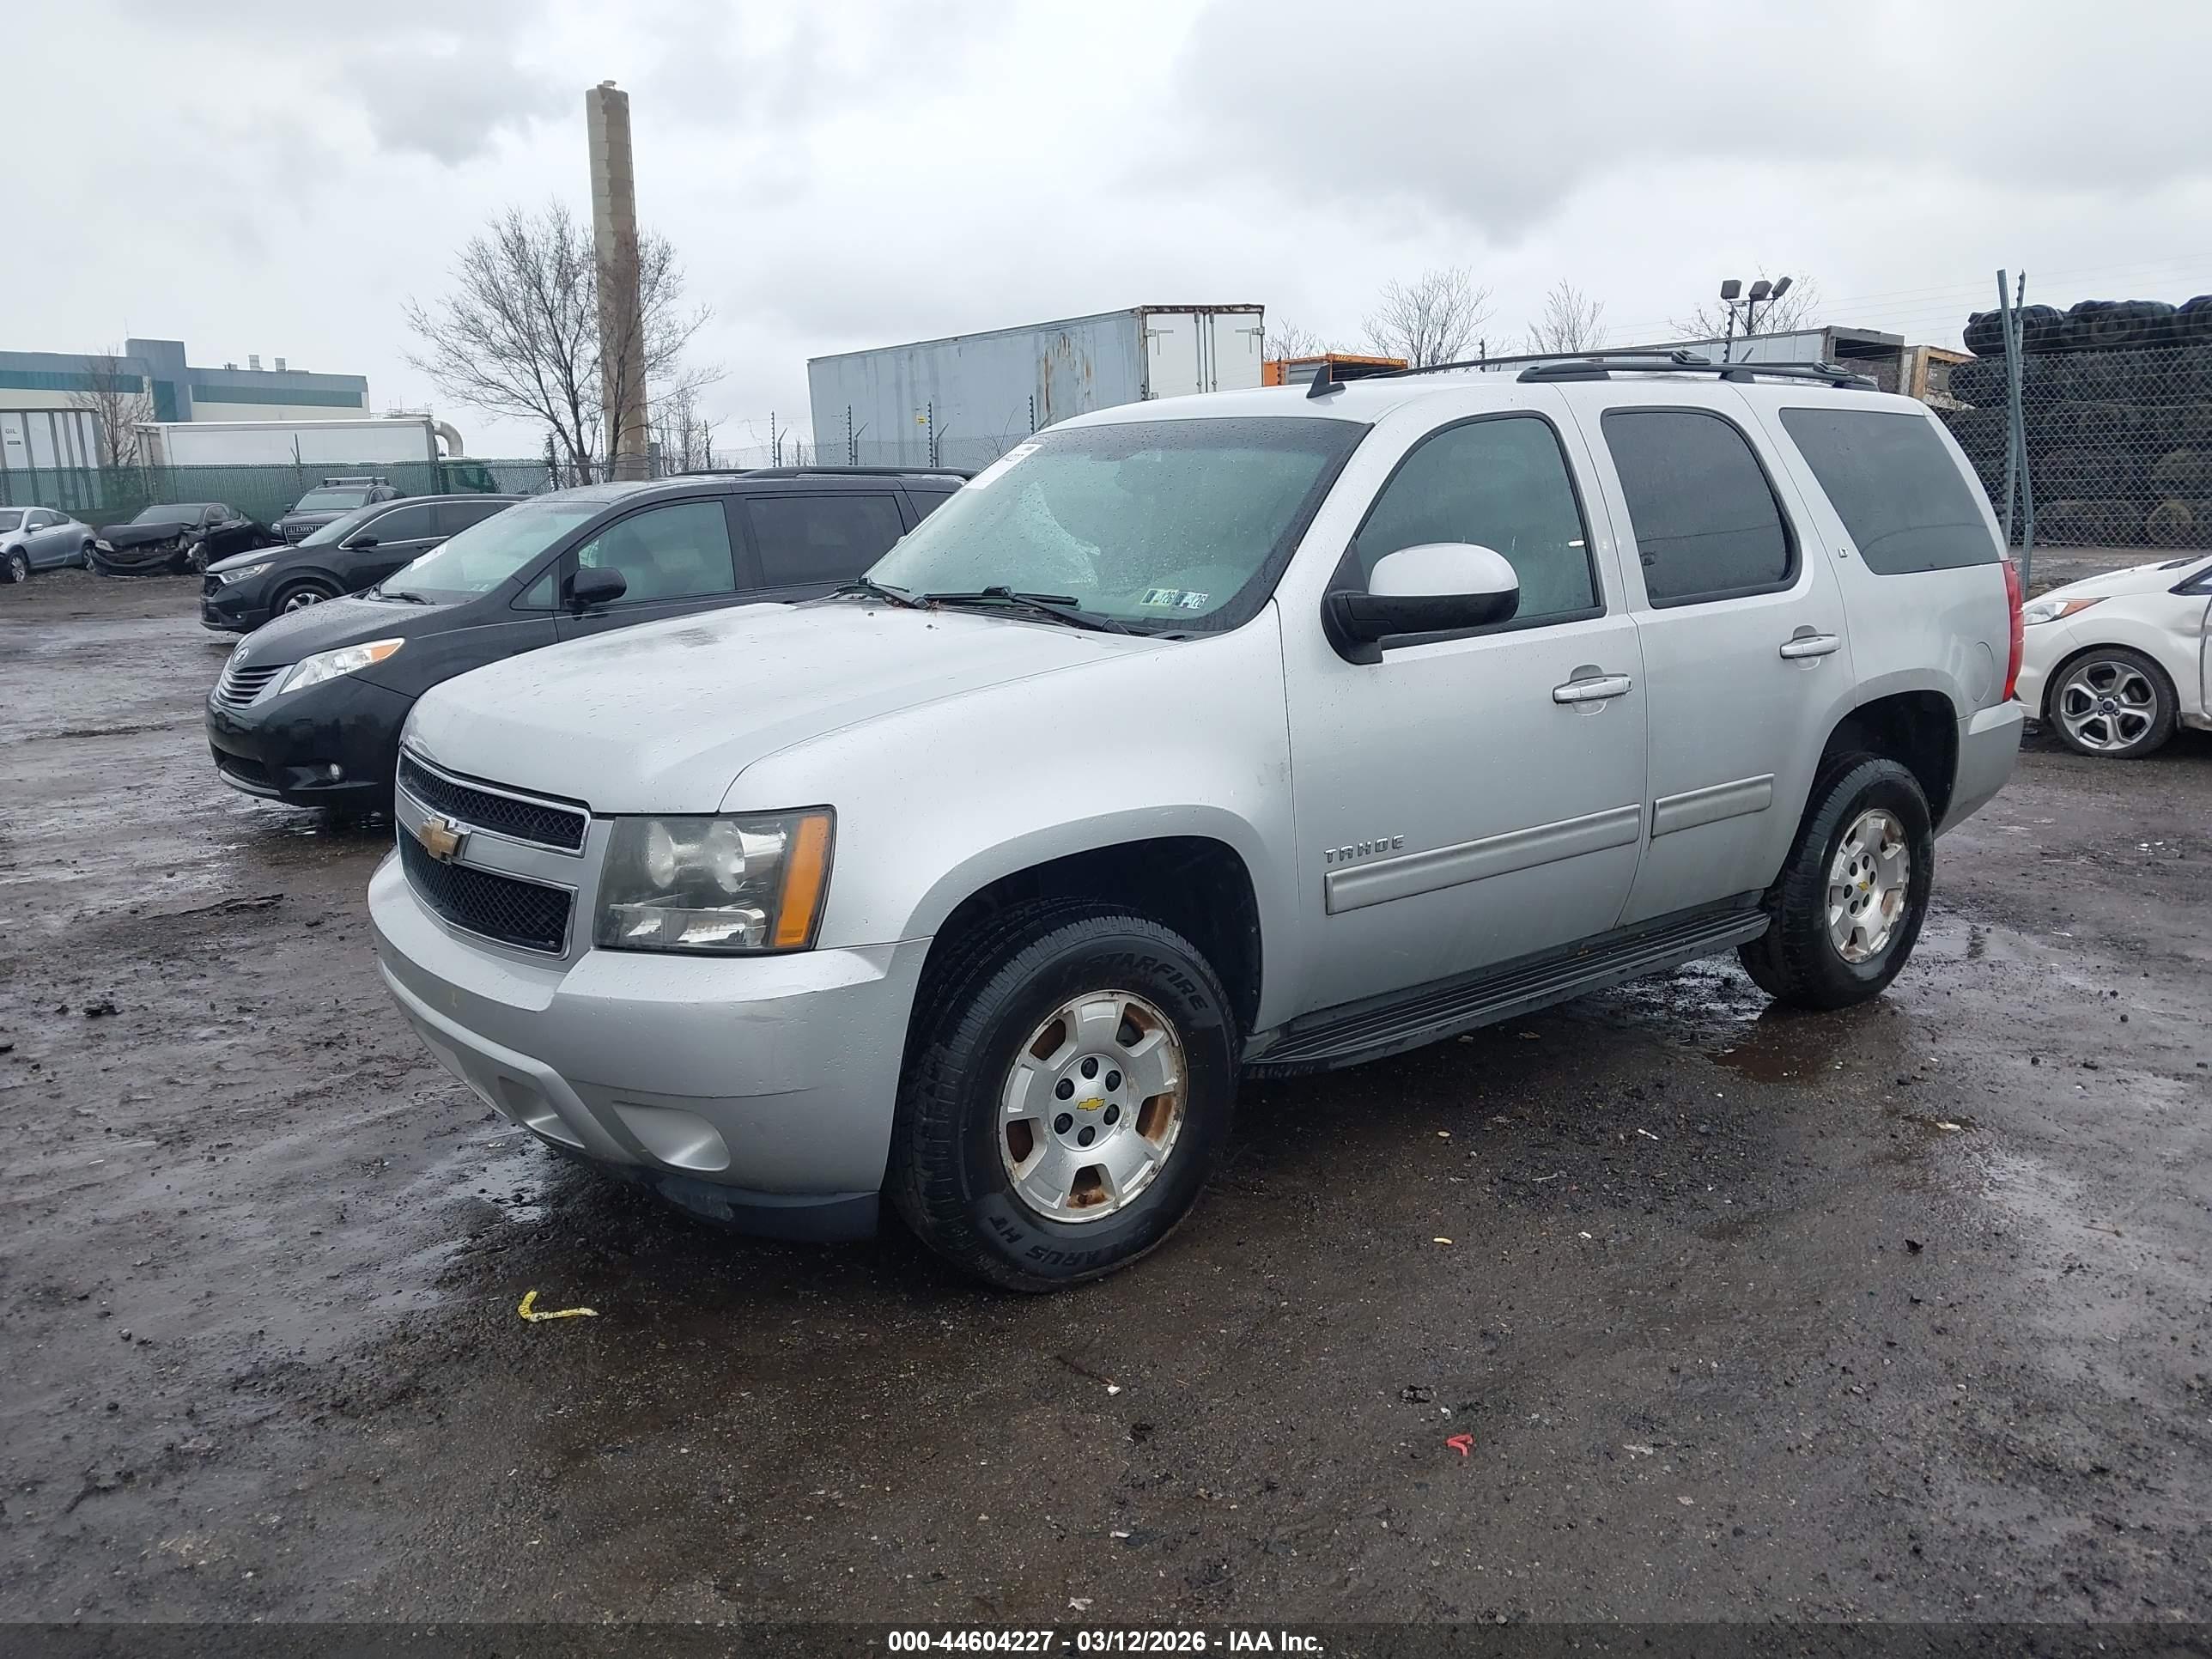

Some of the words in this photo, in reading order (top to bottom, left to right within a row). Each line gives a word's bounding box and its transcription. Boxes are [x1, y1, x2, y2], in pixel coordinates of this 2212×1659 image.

[1324, 834, 1404, 863] TAHOE
[1085, 951, 1209, 1010] STARFIRE
[988, 1216, 1024, 1243] HT
